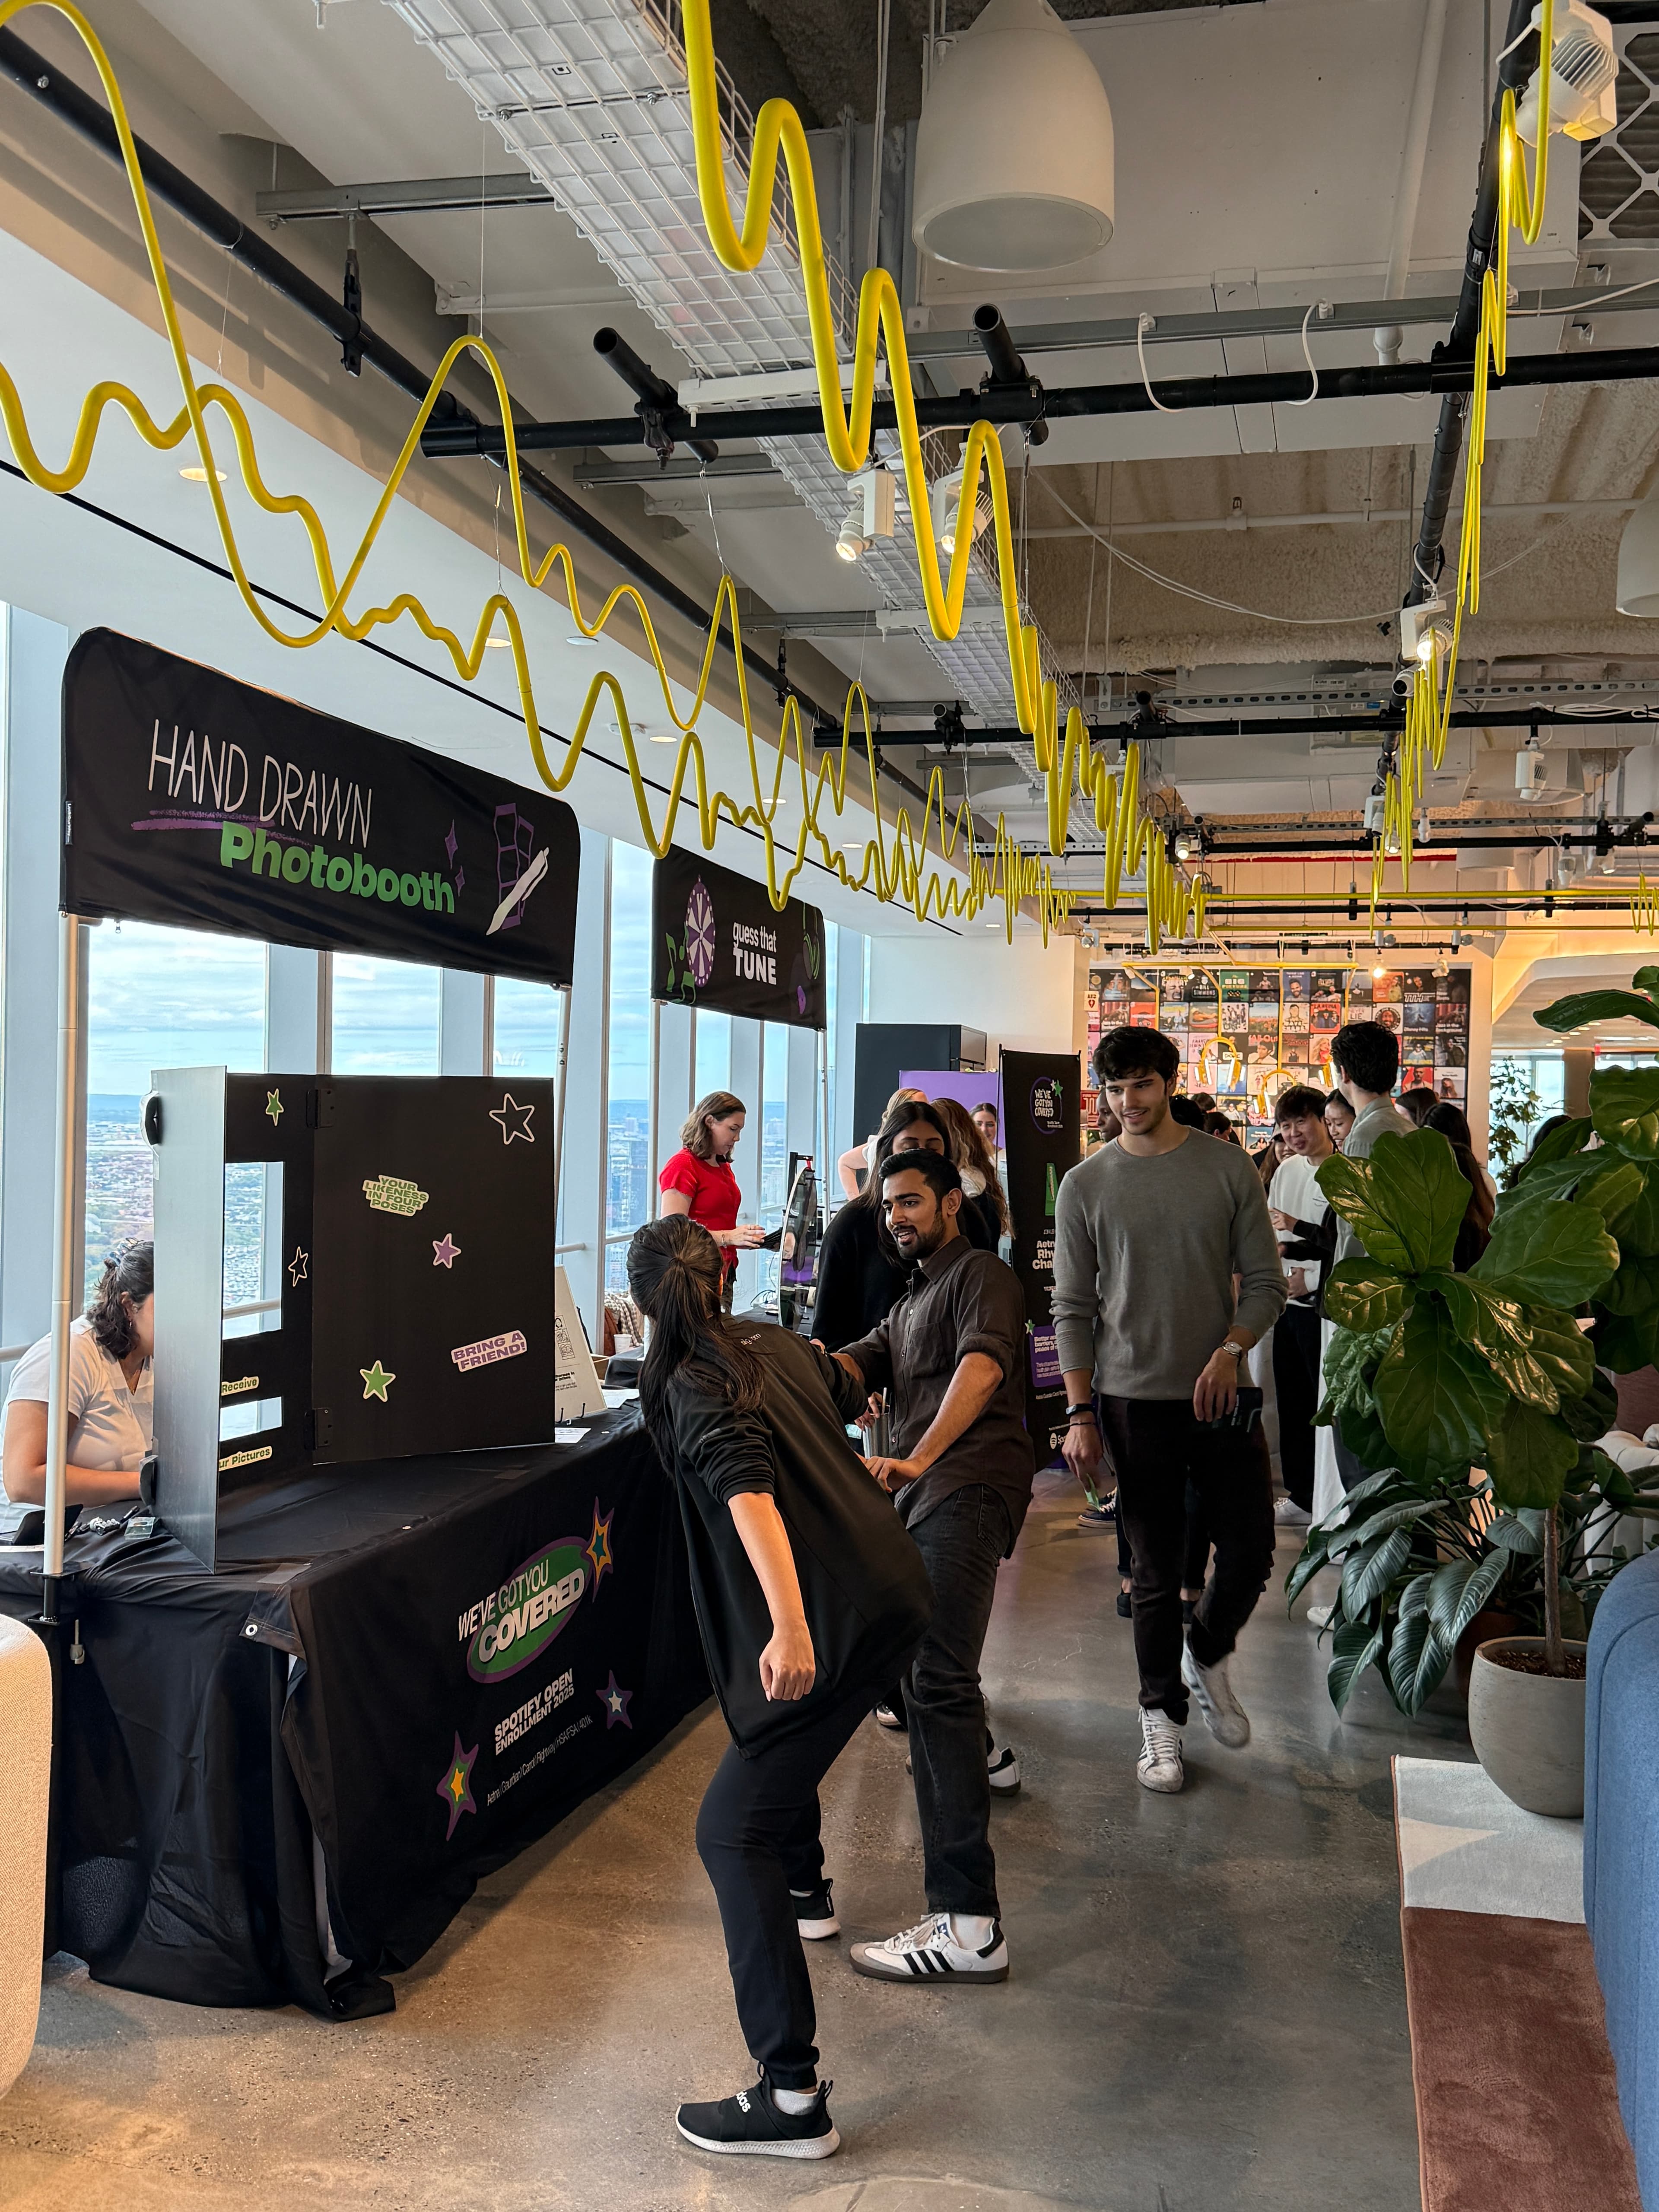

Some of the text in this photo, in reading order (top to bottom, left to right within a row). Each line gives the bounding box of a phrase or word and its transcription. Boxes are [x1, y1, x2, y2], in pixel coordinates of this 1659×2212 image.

[147, 718, 372, 848] HAND DRAWN
[220, 820, 456, 914] Photobooth
[733, 922, 777, 953] guess that
[733, 947, 777, 985] TUNE
[365, 1182, 427, 1201] LIKENESS
[381, 1177, 416, 1192] YOUR
[368, 1190, 421, 1208] IN FOUR
[372, 1199, 414, 1214] POSES
[1032, 1259, 1053, 1270] Cha
[454, 1332, 523, 1360] BRING A
[460, 1341, 526, 1370] FRIEND!
[222, 1378, 257, 1393] Receive
[219, 1448, 270, 1468] ur Pictures
[458, 1592, 496, 1641] WE'VE
[478, 1567, 585, 1663] COVERED
[495, 1668, 573, 1742] SPOTIFY OPEN
[495, 1683, 574, 1756] ENROLLMENT 2025
[522, 1757, 535, 1776] Carrot
[736, 2089, 751, 2113] das
